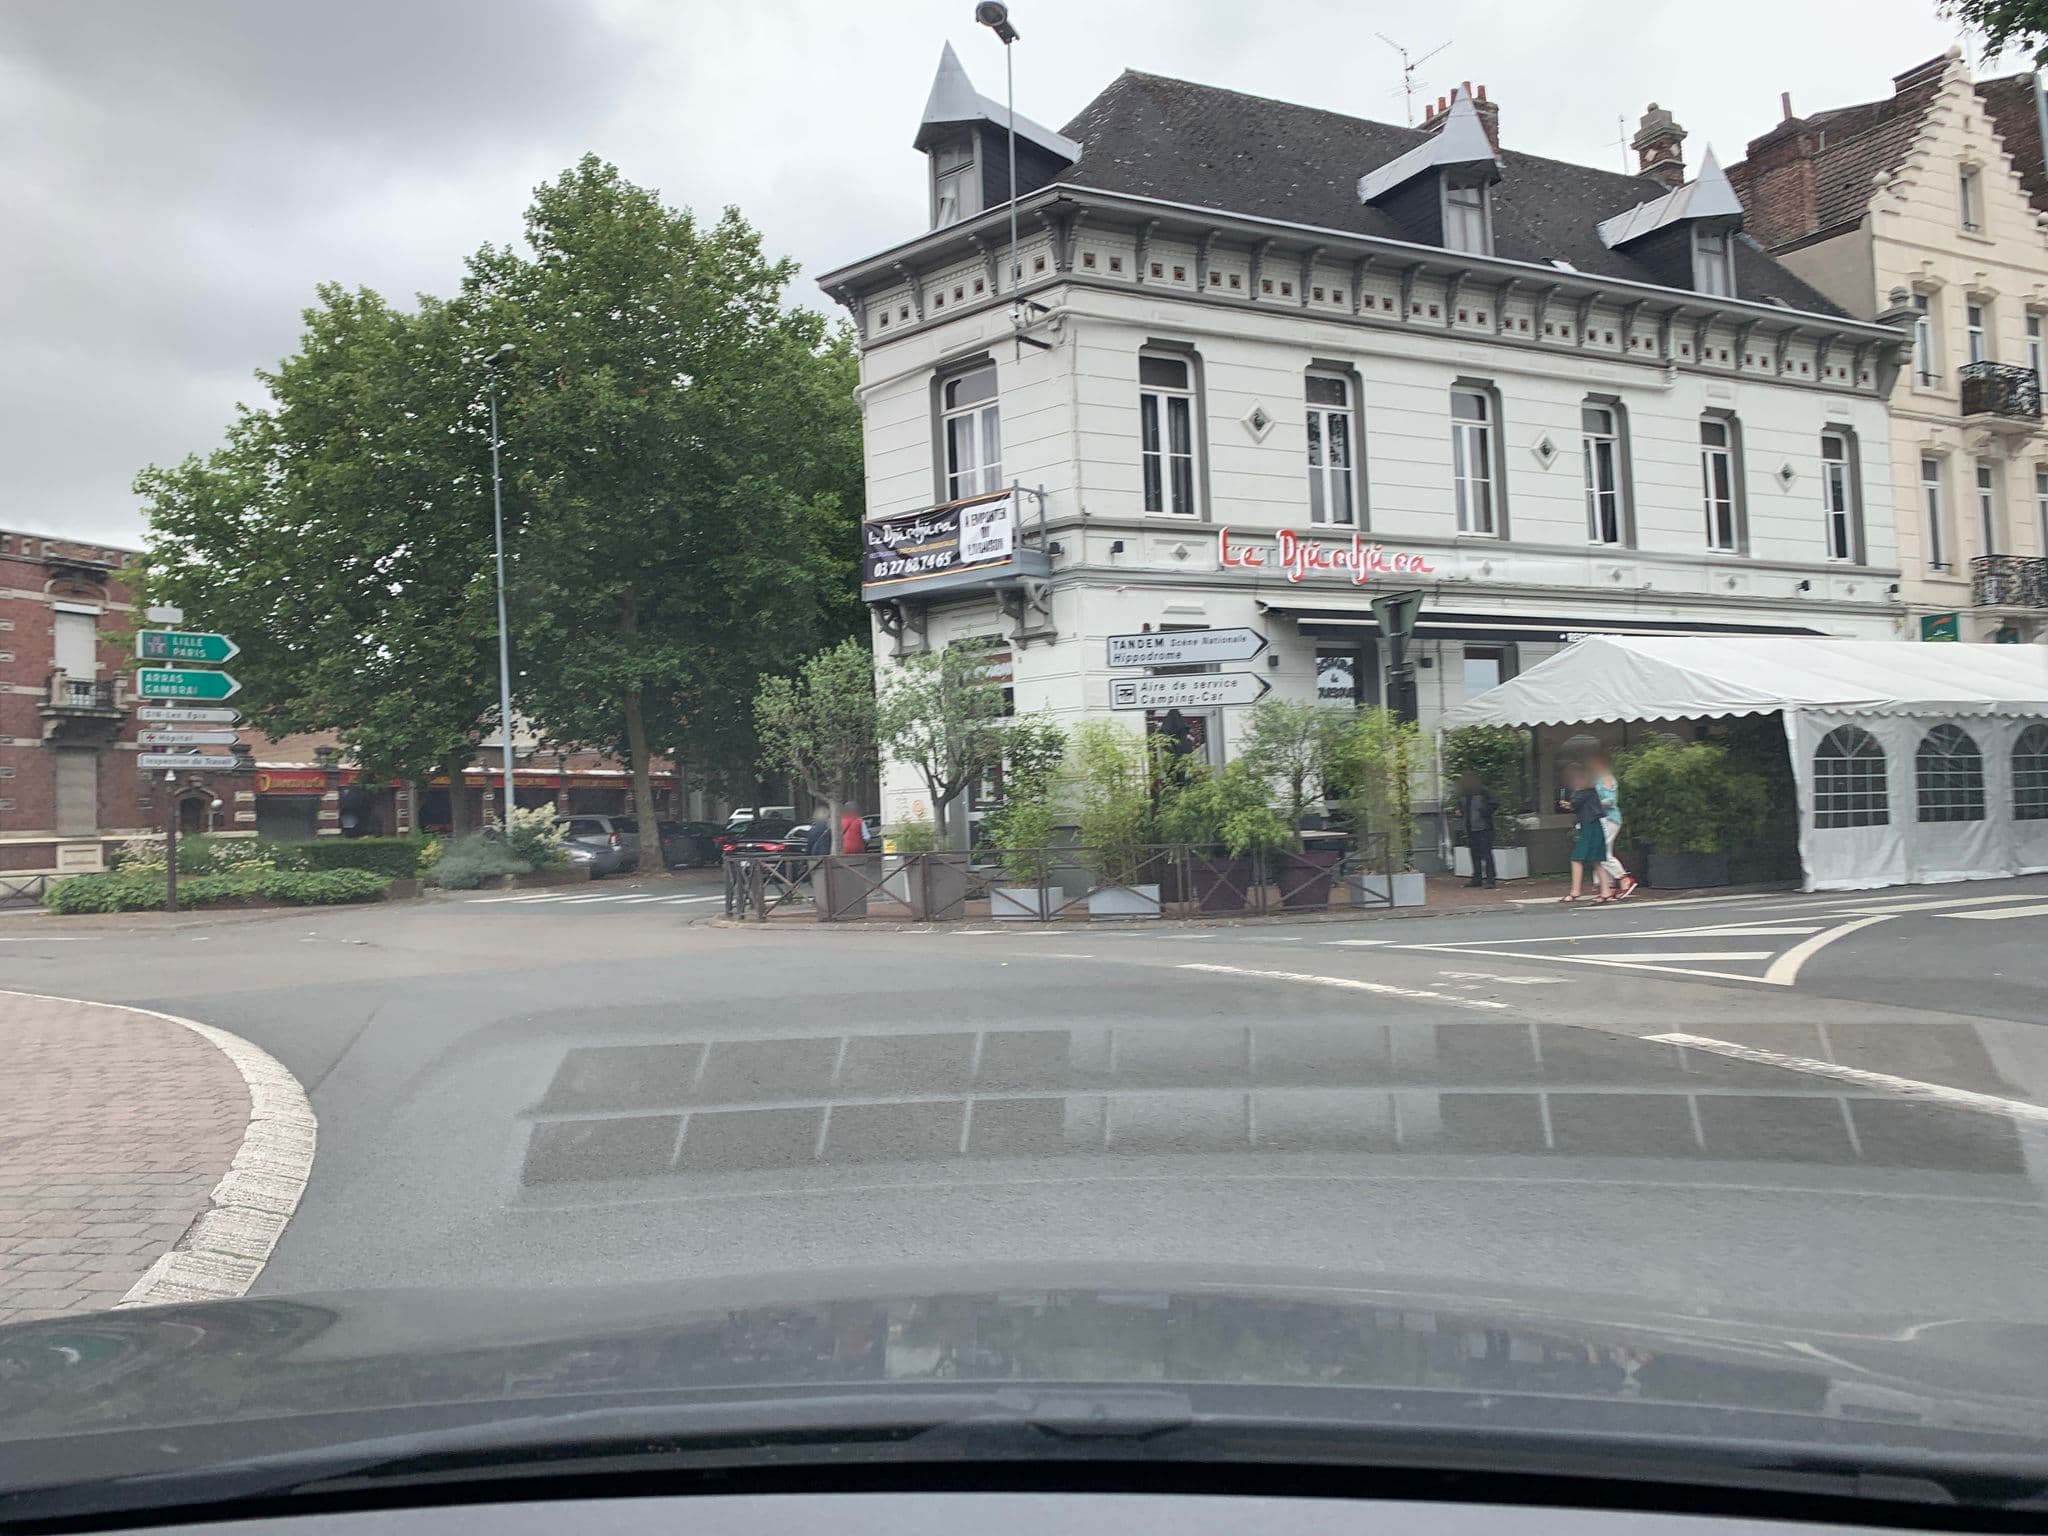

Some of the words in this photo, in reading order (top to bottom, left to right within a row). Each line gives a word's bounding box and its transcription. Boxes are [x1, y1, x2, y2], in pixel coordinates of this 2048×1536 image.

[1218, 526, 1265, 568] Le
[172, 637, 204, 647] LILLE
[1112, 637, 1165, 650] TANDEM
[1170, 638, 1198, 648] Scène
[1201, 635, 1248, 646] Nationale
[173, 647, 206, 658] PARIS
[1113, 651, 1183, 664] Hippodrome
[144, 673, 184, 683] ARRAS
[144, 684, 199, 695] CAMBRAI
[1141, 681, 1167, 692] Aire
[1171, 680, 1186, 690] de
[1193, 677, 1239, 688] service
[1141, 691, 1224, 706] Camping-Car
[158, 734, 193, 743] Hôpital
